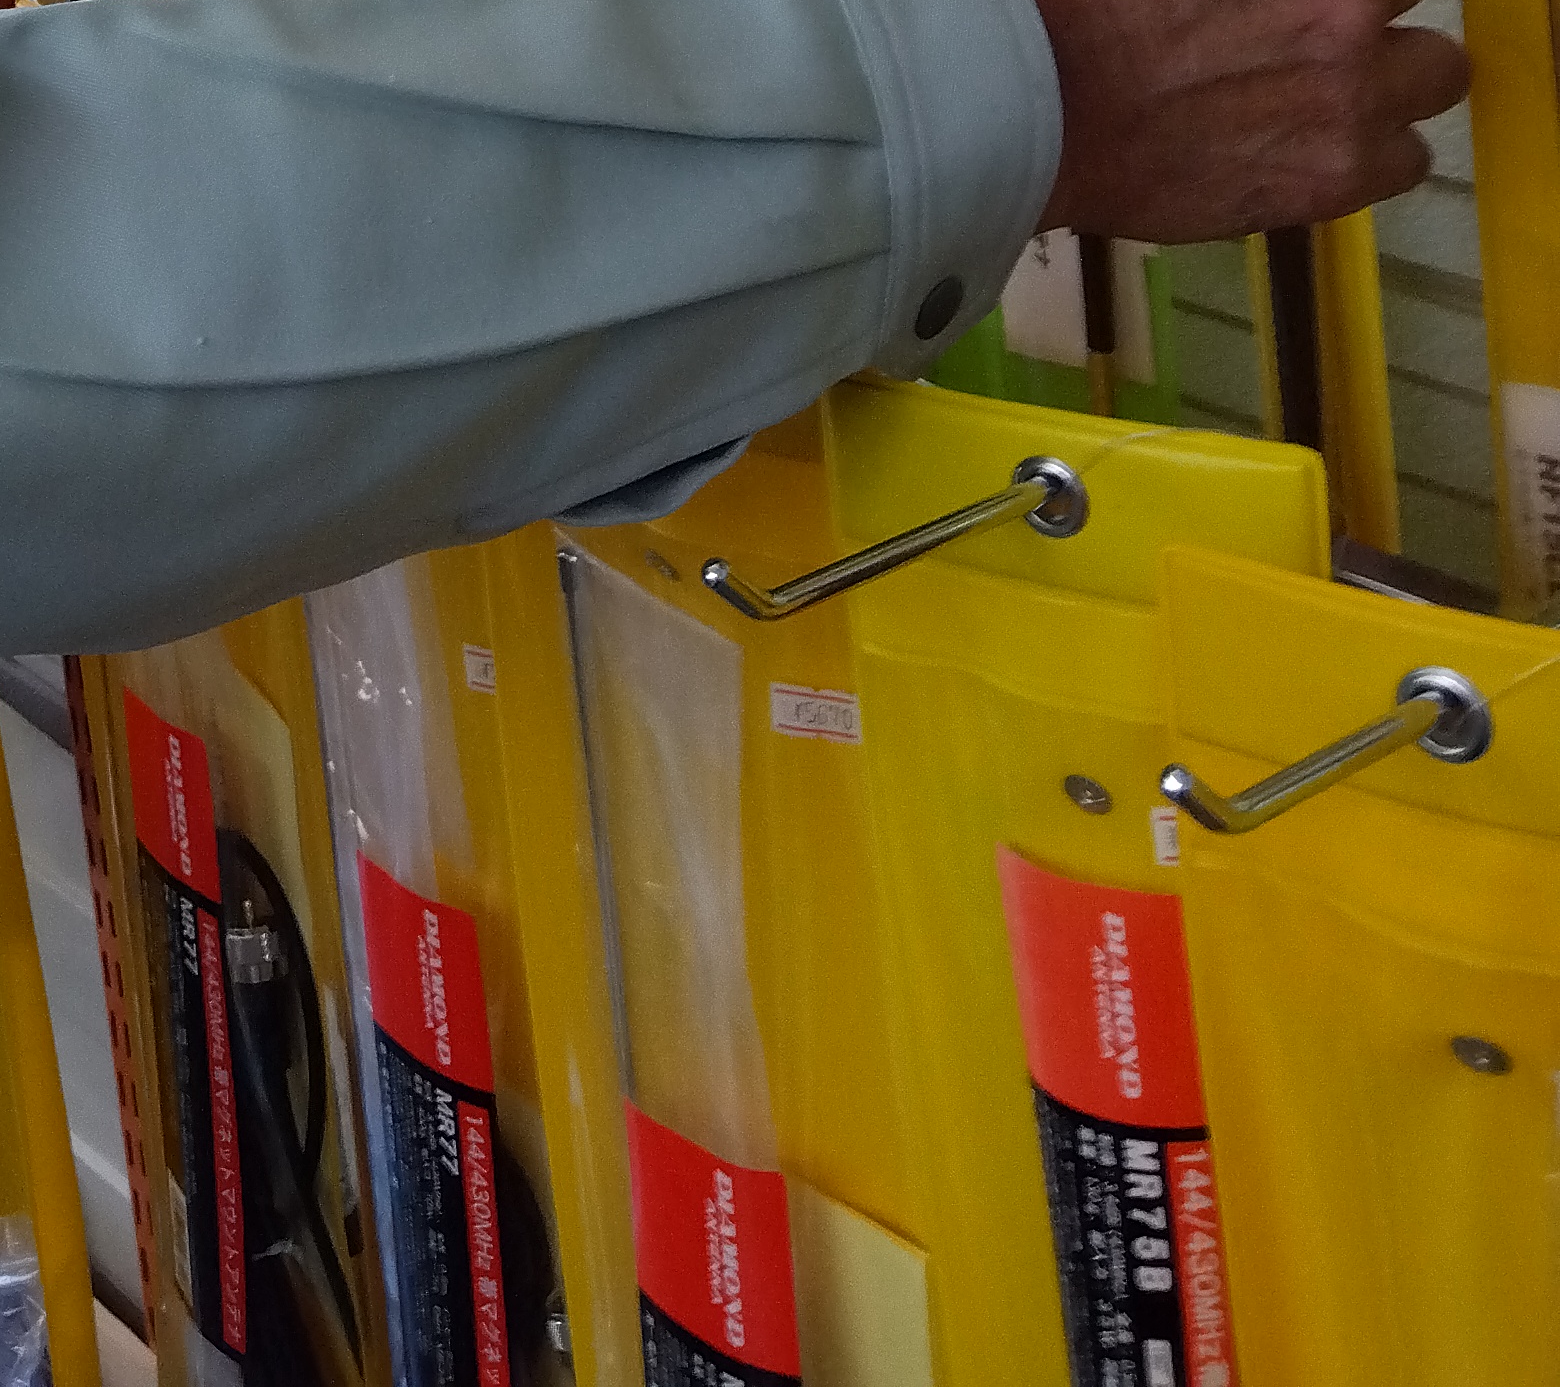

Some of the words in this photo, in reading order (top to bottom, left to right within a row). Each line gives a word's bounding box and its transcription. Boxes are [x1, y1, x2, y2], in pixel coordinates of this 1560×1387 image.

[168, 734, 193, 877] DIAMOND
[179, 896, 199, 976] MR77
[423, 908, 452, 1066] DIAMOND
[1101, 911, 1143, 1099] DIAMOND
[434, 1088, 460, 1177] MR77
[712, 1169, 746, 1348] DIAMOND
